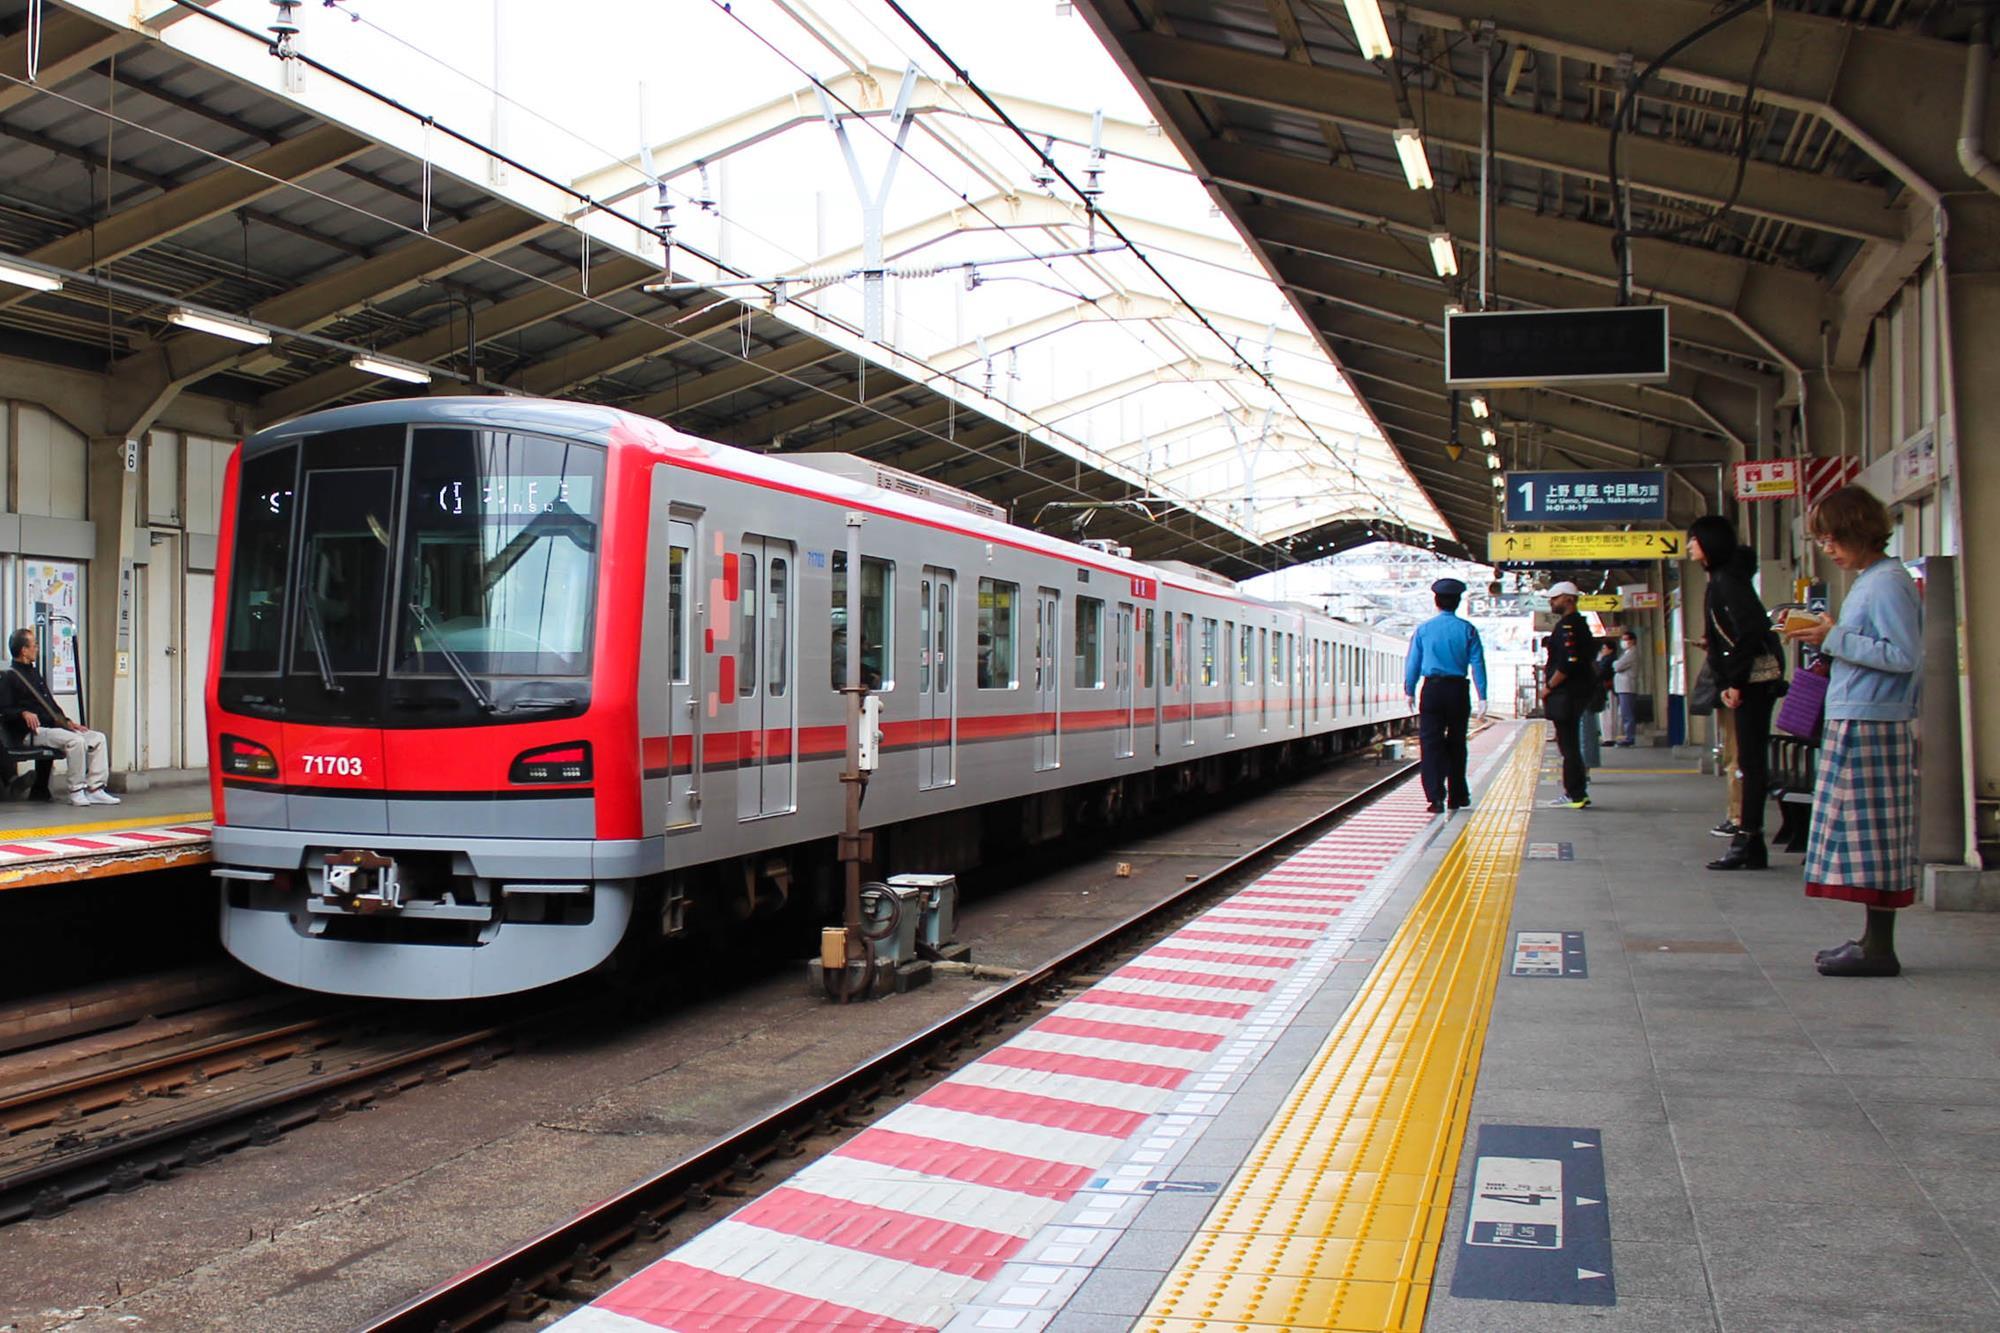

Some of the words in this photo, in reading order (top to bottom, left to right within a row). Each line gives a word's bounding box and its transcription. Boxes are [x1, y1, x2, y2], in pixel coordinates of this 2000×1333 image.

[127, 453, 136, 469] 6
[1517, 481, 1534, 512] 1
[1545, 484, 1571, 497] 上野
[1573, 484, 1599, 497] 銀座
[1603, 483, 1660, 497] 中目黒方面
[1645, 534, 1654, 546] 2
[302, 755, 363, 776] 71703
